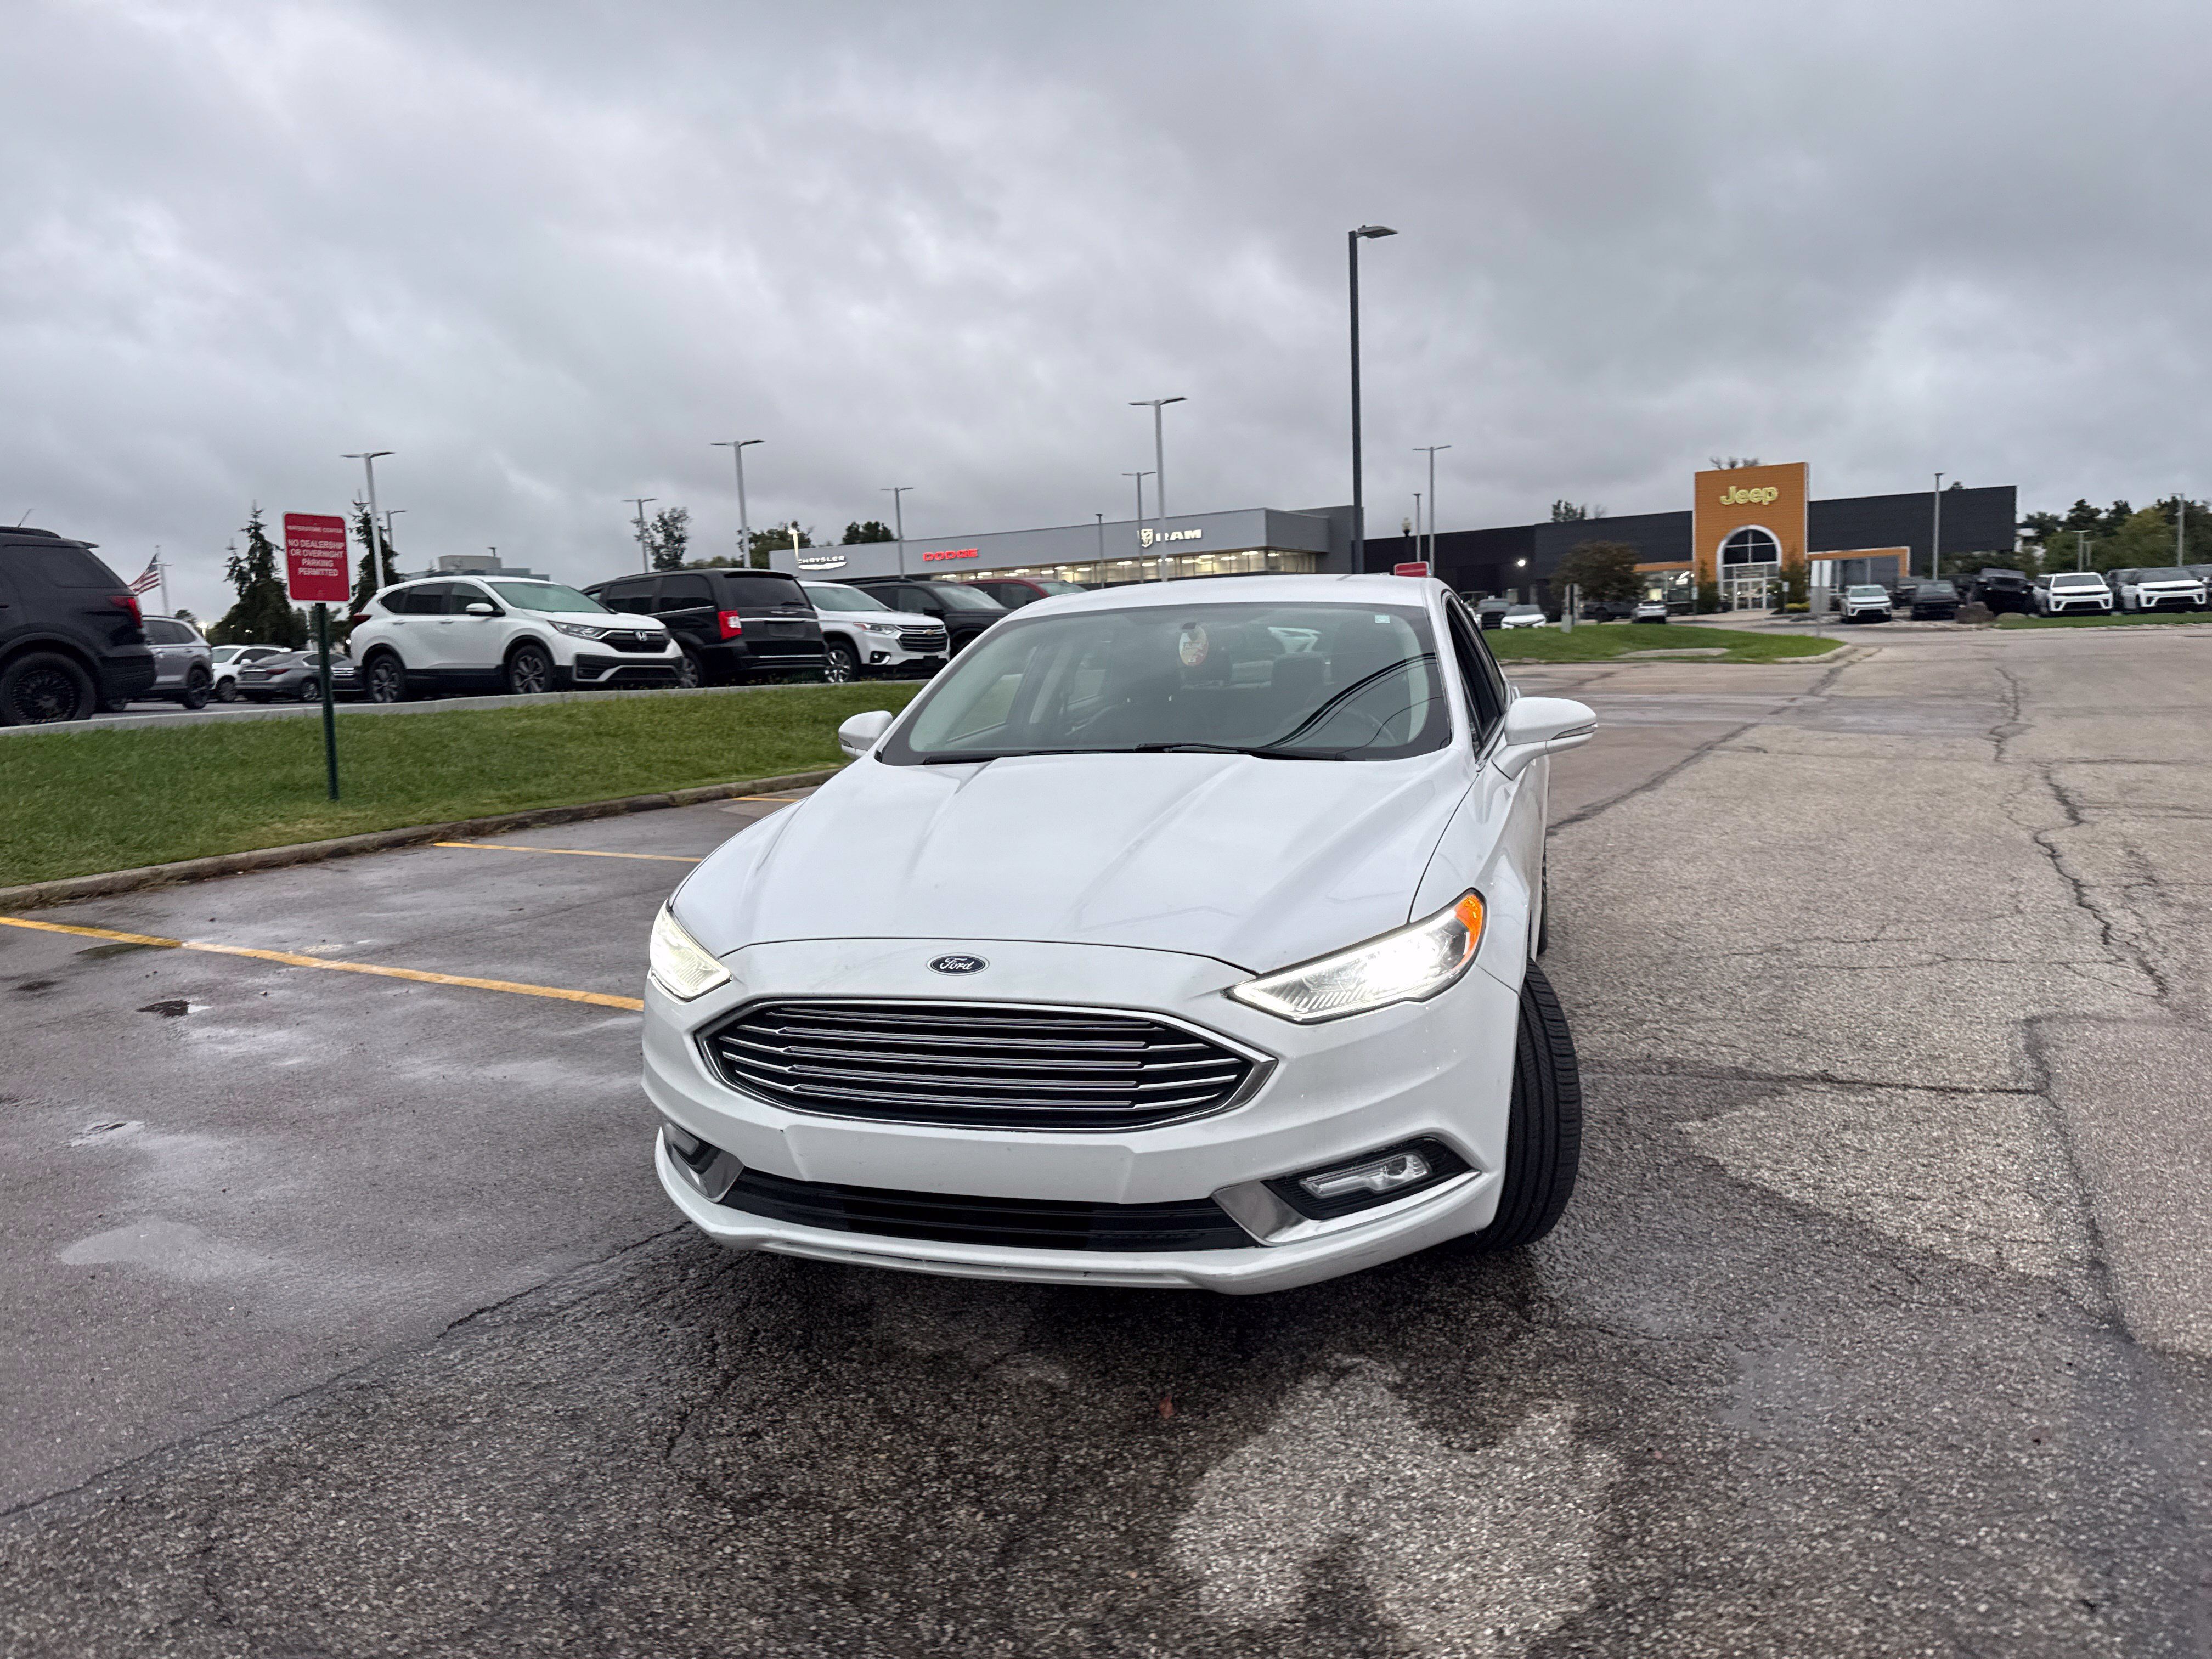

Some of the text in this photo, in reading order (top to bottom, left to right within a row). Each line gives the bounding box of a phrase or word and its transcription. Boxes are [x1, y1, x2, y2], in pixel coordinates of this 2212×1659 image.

[1720, 486, 1778, 505] Jeep
[1155, 529, 1201, 542] RAM
[300, 539, 345, 549] DEALERSHIP
[302, 549, 343, 558] OVERNIGHT
[923, 549, 978, 561] DODGE
[302, 558, 334, 567] PARKING
[298, 567, 339, 576] PERMITTED
[939, 957, 975, 970] Ford
